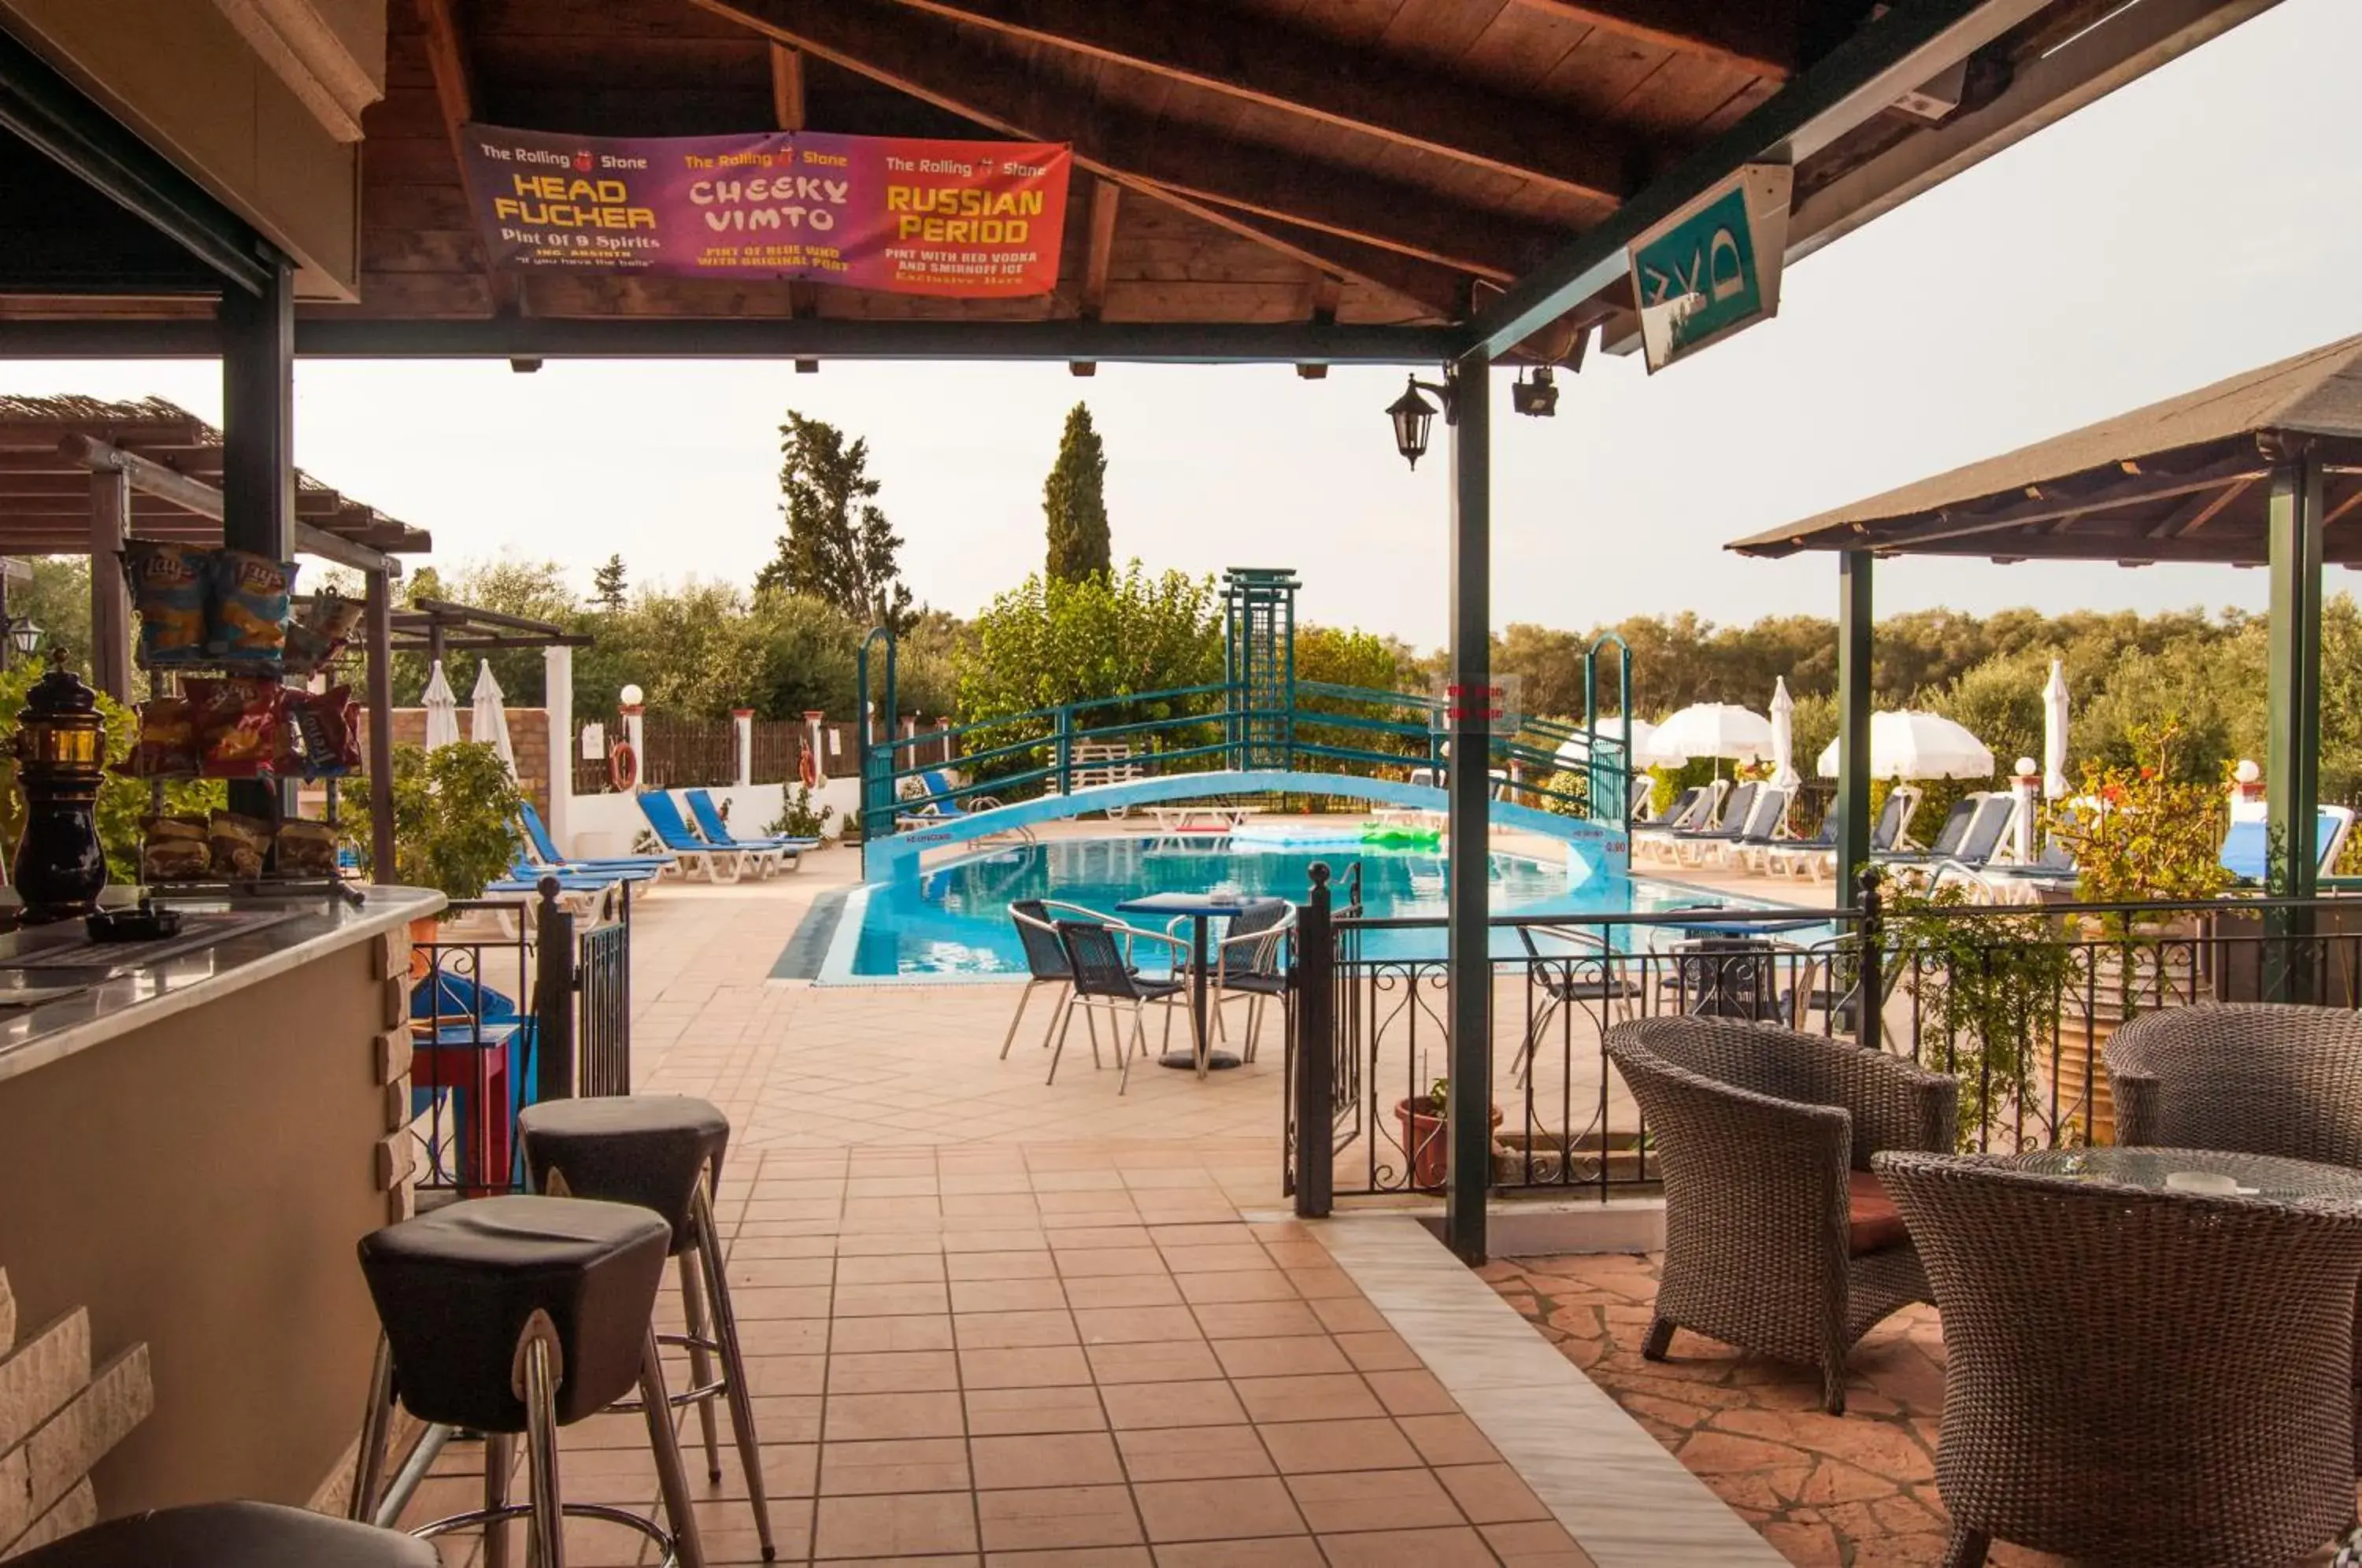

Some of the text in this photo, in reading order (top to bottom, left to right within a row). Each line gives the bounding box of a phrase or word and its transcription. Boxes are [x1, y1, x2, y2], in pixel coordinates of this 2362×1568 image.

[480, 143, 648, 169] The Rolling Stone
[685, 150, 848, 169] The Rolling Stone
[886, 157, 1046, 177] The Rolling Stone
[513, 173, 628, 203] HEAD
[689, 176, 849, 205] CHEEKY
[887, 185, 1044, 216] RUSSIAN
[705, 205, 834, 232] VIMTO
[898, 214, 1028, 243] PERIOD
[501, 227, 542, 246] Pint
[596, 235, 661, 250] Spirits
[885, 248, 917, 259] PINT
[920, 250, 957, 262] WITH
[991, 252, 1038, 263] VODKA
[898, 261, 927, 272] AND
